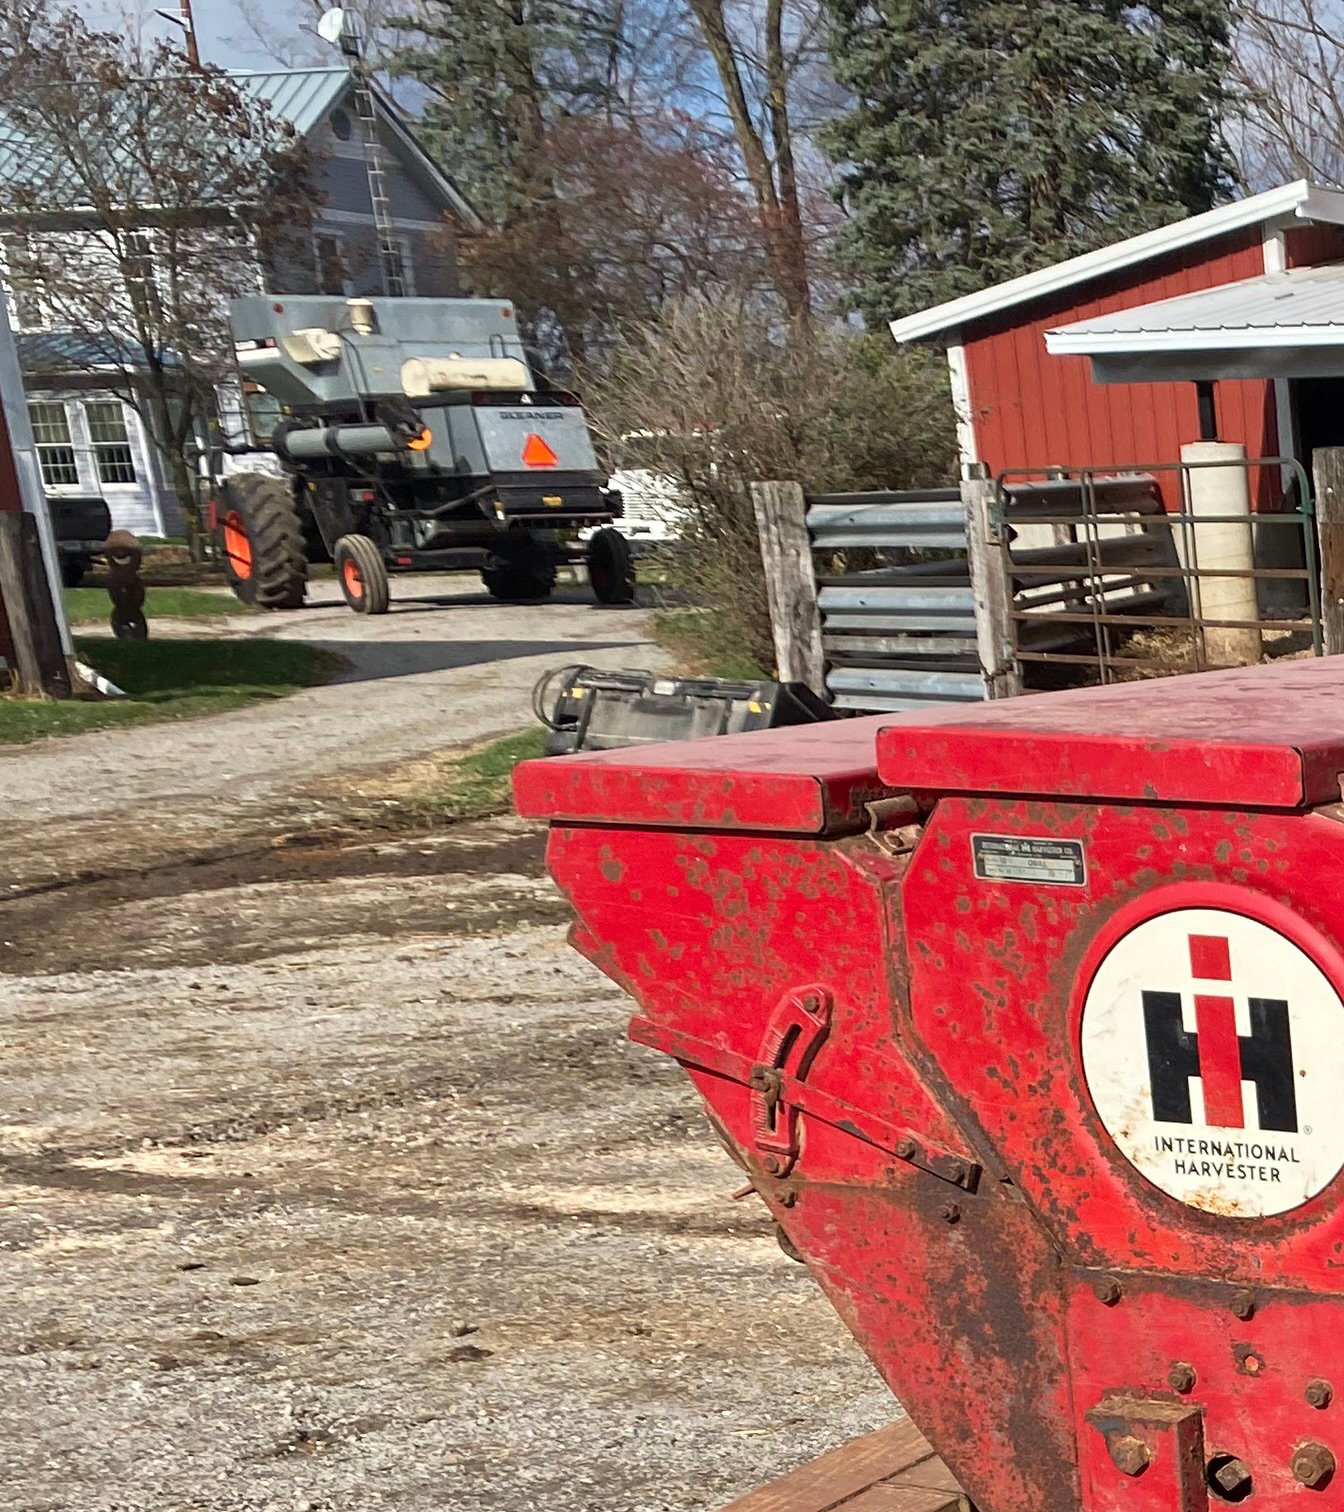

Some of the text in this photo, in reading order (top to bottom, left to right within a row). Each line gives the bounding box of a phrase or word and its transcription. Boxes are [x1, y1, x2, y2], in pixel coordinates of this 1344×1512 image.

[499, 411, 564, 420] GLEANER
[1154, 1136, 1300, 1163] INTERNATIONAL
[1174, 1159, 1281, 1183] HARVESTER
